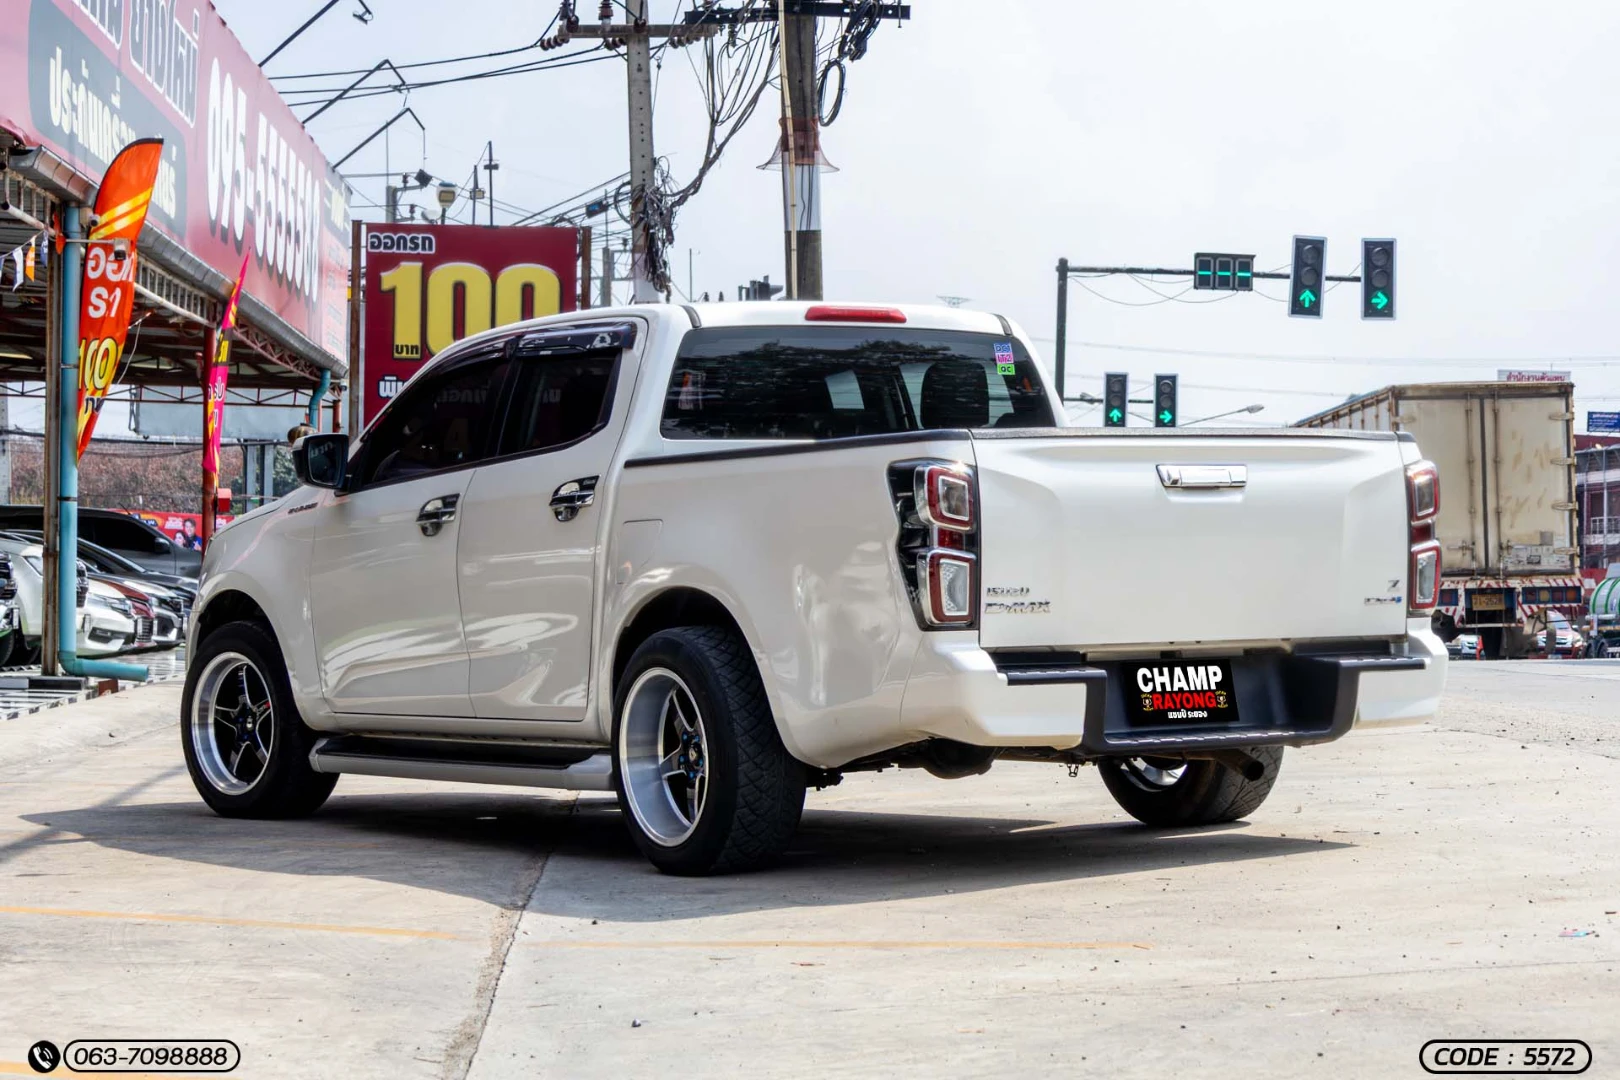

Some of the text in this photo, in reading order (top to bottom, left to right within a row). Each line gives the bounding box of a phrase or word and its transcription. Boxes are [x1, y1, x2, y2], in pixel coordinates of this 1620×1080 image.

[207, 56, 321, 303] 095-5555588
[368, 232, 435, 253] ออกรถ
[380, 262, 561, 360] 100
[395, 344, 419, 355] บาท
[1136, 665, 1223, 693] CHAMP
[1151, 691, 1217, 710] RAYONG
